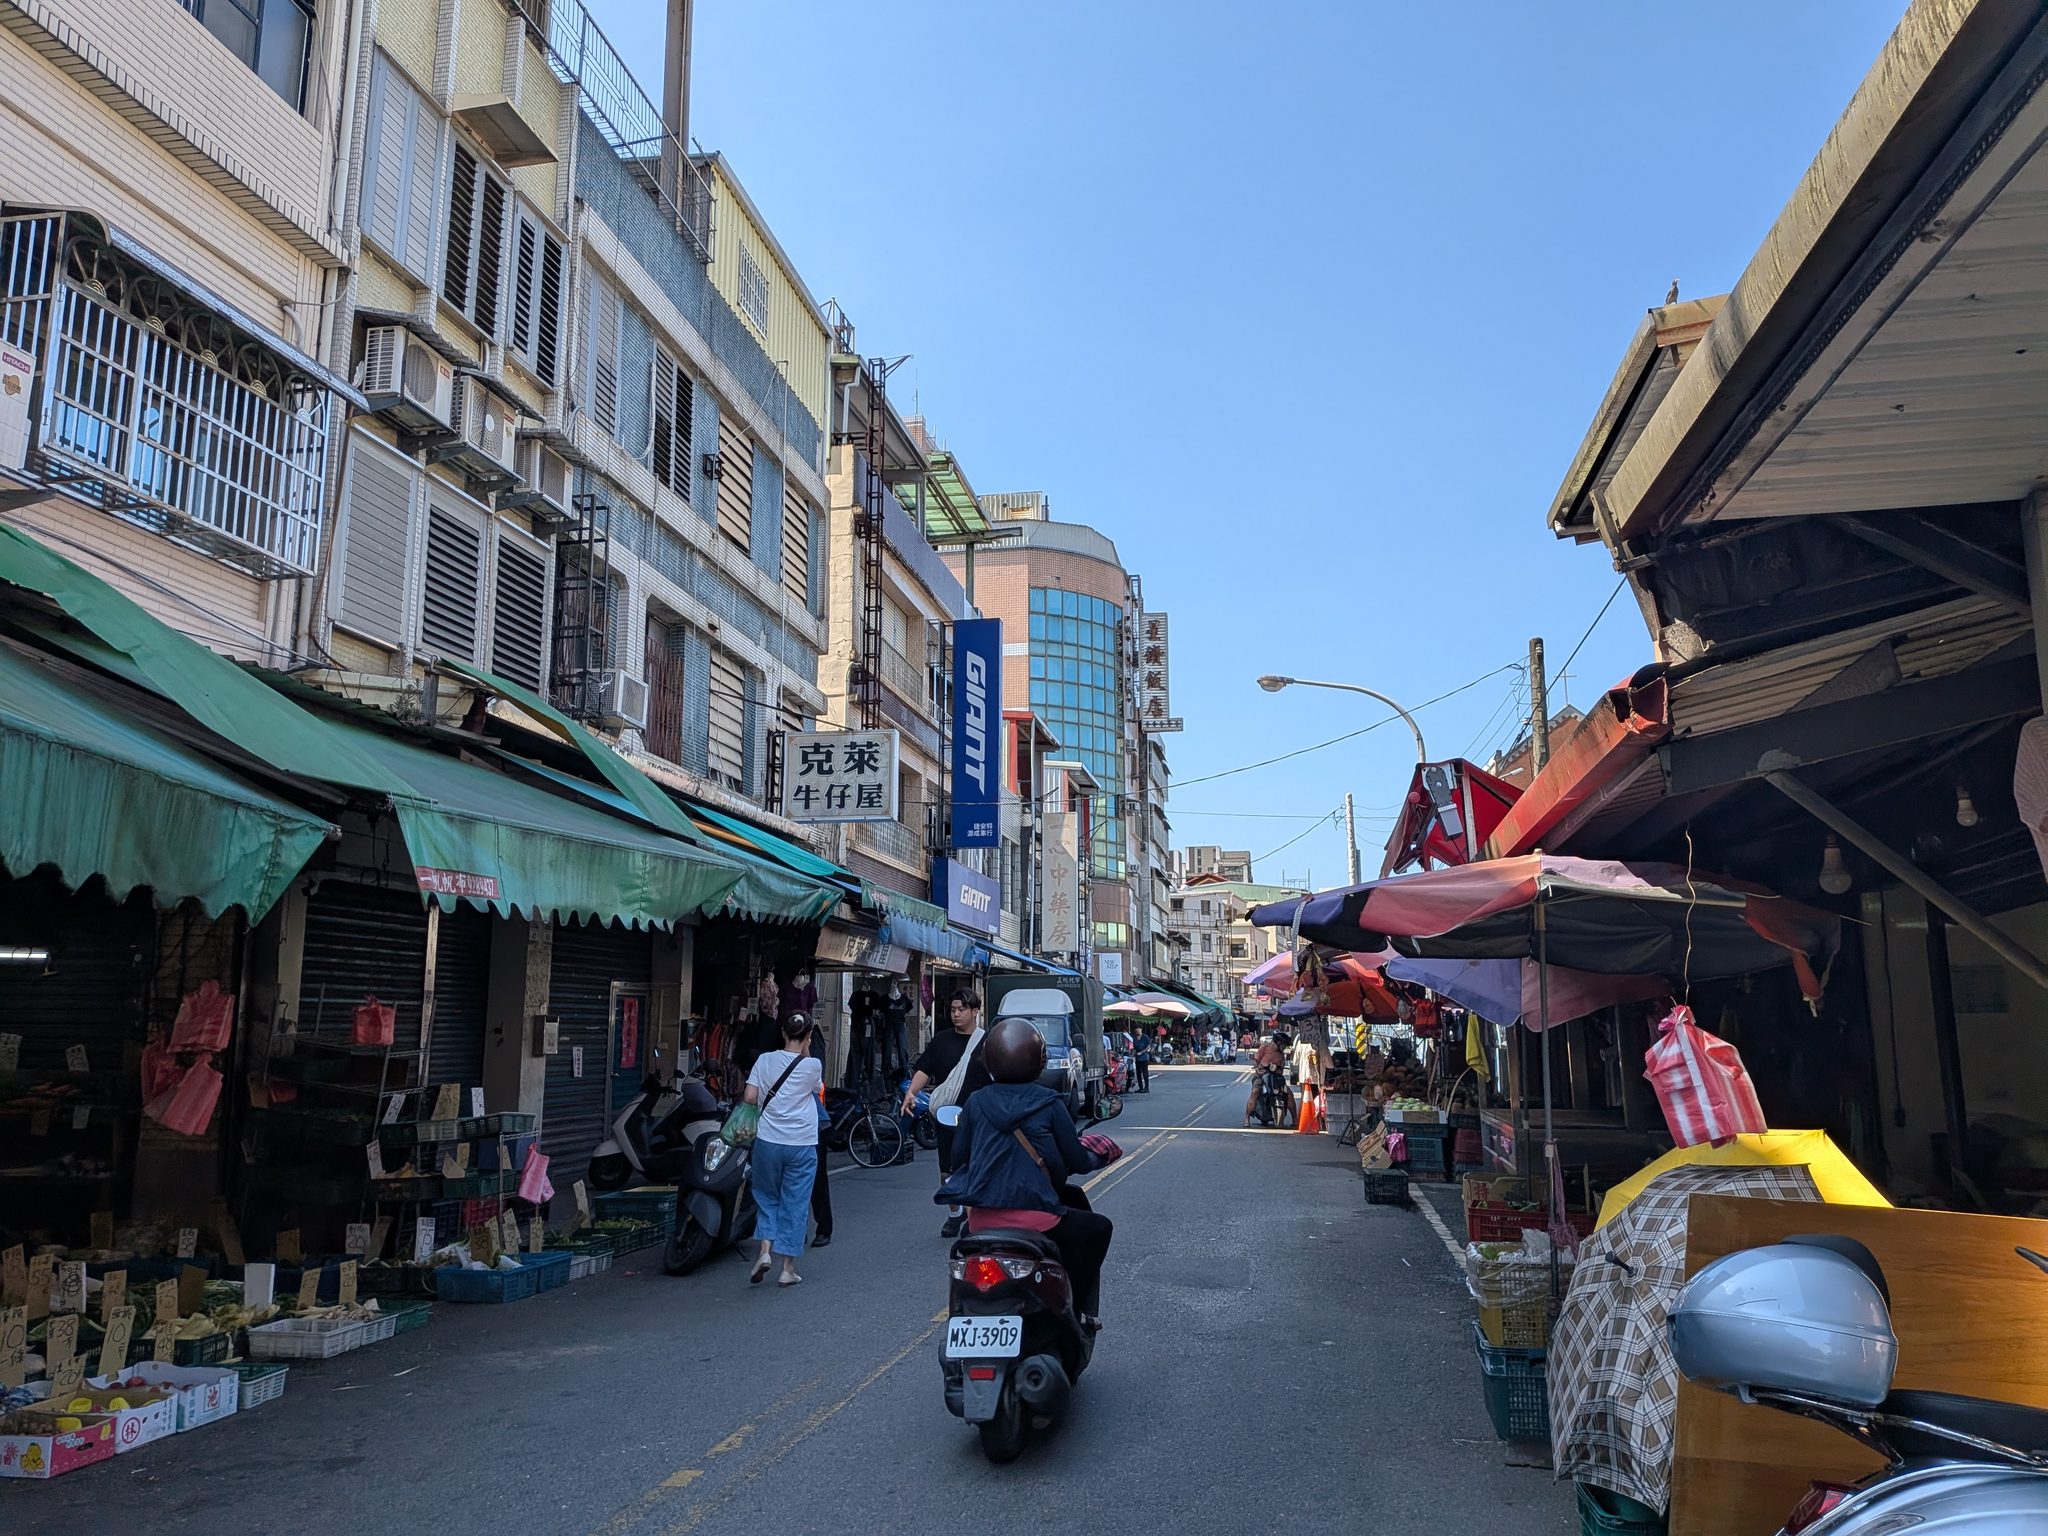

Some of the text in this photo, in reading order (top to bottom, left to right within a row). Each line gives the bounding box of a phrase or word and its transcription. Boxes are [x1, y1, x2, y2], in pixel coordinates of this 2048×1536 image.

[964, 650, 986, 797] GIANT
[799, 740, 880, 776] 克萊
[793, 783, 884, 810] 牛仔屋
[1047, 823, 1072, 946] 一心中藥房
[960, 884, 991, 913] GIANT
[1, 1323, 25, 1350] 10
[107, 1323, 126, 1343] 10
[59, 1369, 80, 1386] 20
[125, 1422, 137, 1440] 林
